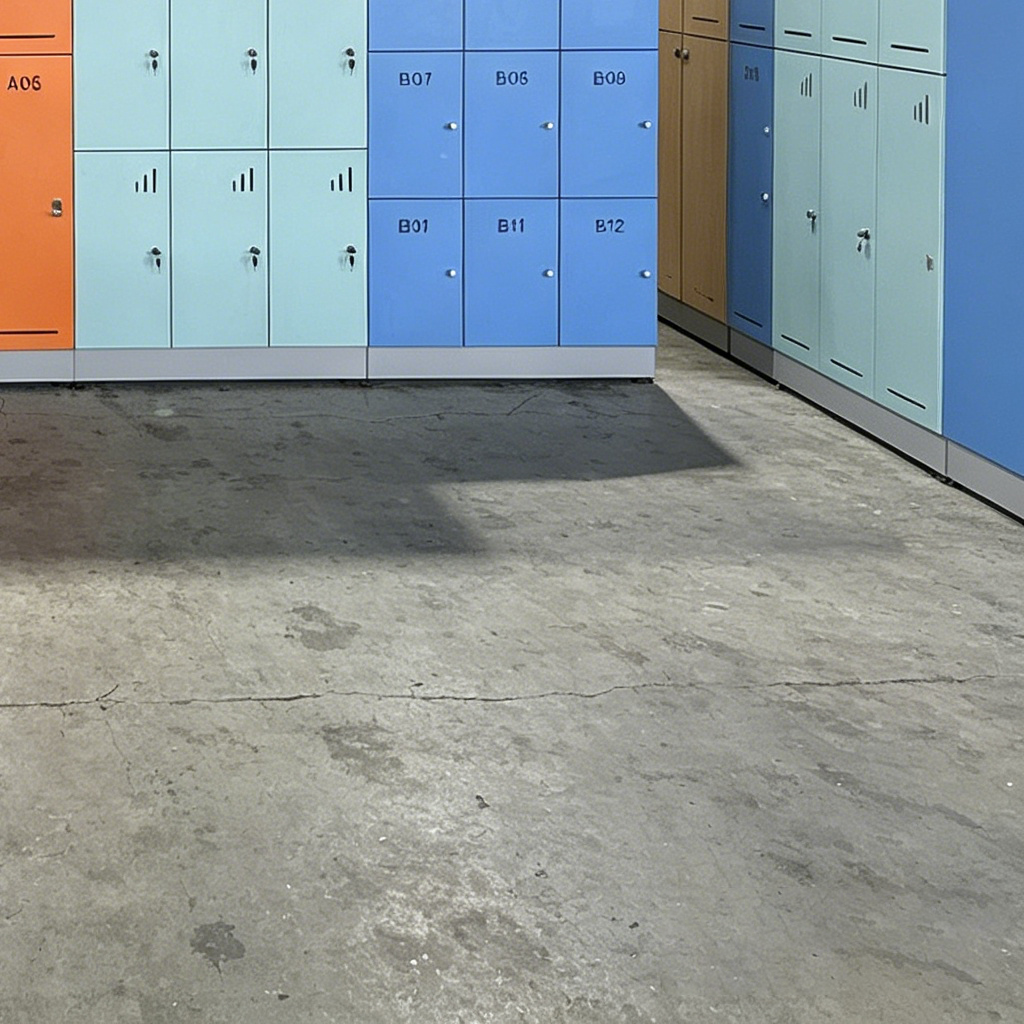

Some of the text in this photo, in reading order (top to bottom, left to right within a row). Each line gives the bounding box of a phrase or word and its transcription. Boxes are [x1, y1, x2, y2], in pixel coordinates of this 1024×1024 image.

[6, 75, 42, 91] A06
[399, 72, 432, 86] B07
[398, 219, 428, 233] B01
[595, 218, 625, 233] B12
